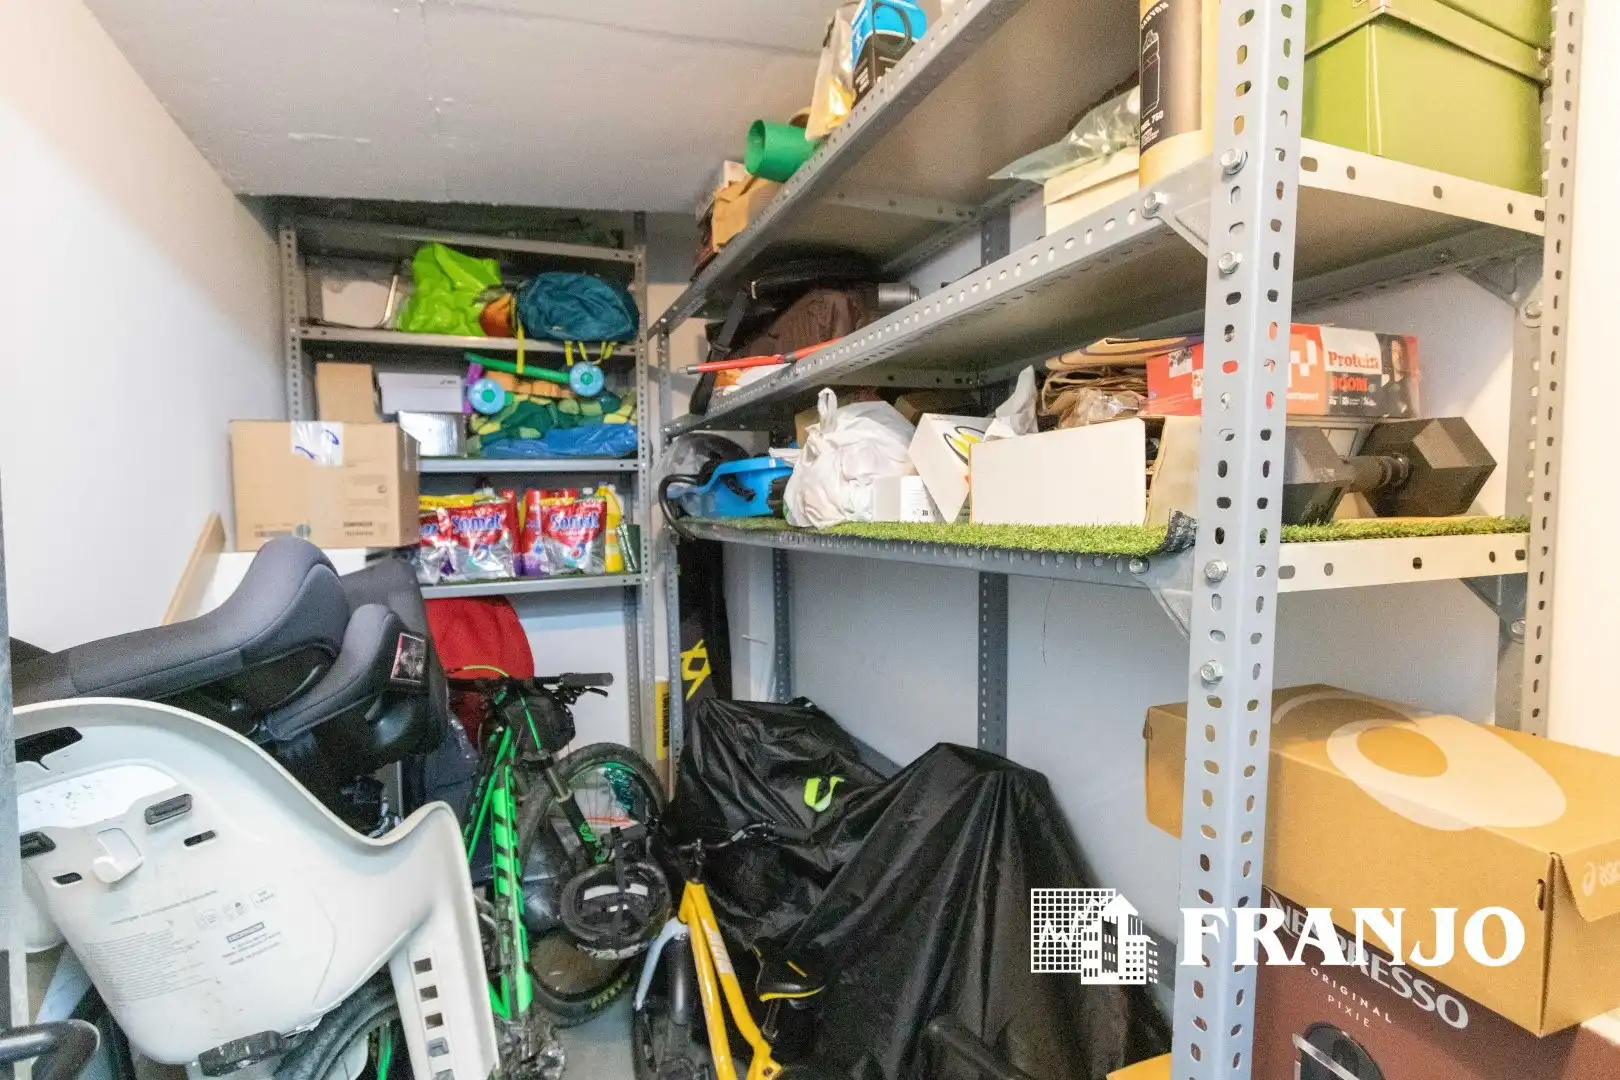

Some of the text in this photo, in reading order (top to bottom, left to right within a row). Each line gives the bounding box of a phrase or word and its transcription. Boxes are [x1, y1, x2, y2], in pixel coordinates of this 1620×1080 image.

[1328, 351, 1379, 369] Protein
[451, 512, 502, 533] Somat
[550, 512, 599, 531] Somat
[1310, 967, 1393, 1024] ORIGINAL
[1327, 994, 1371, 1028] PIXIE
